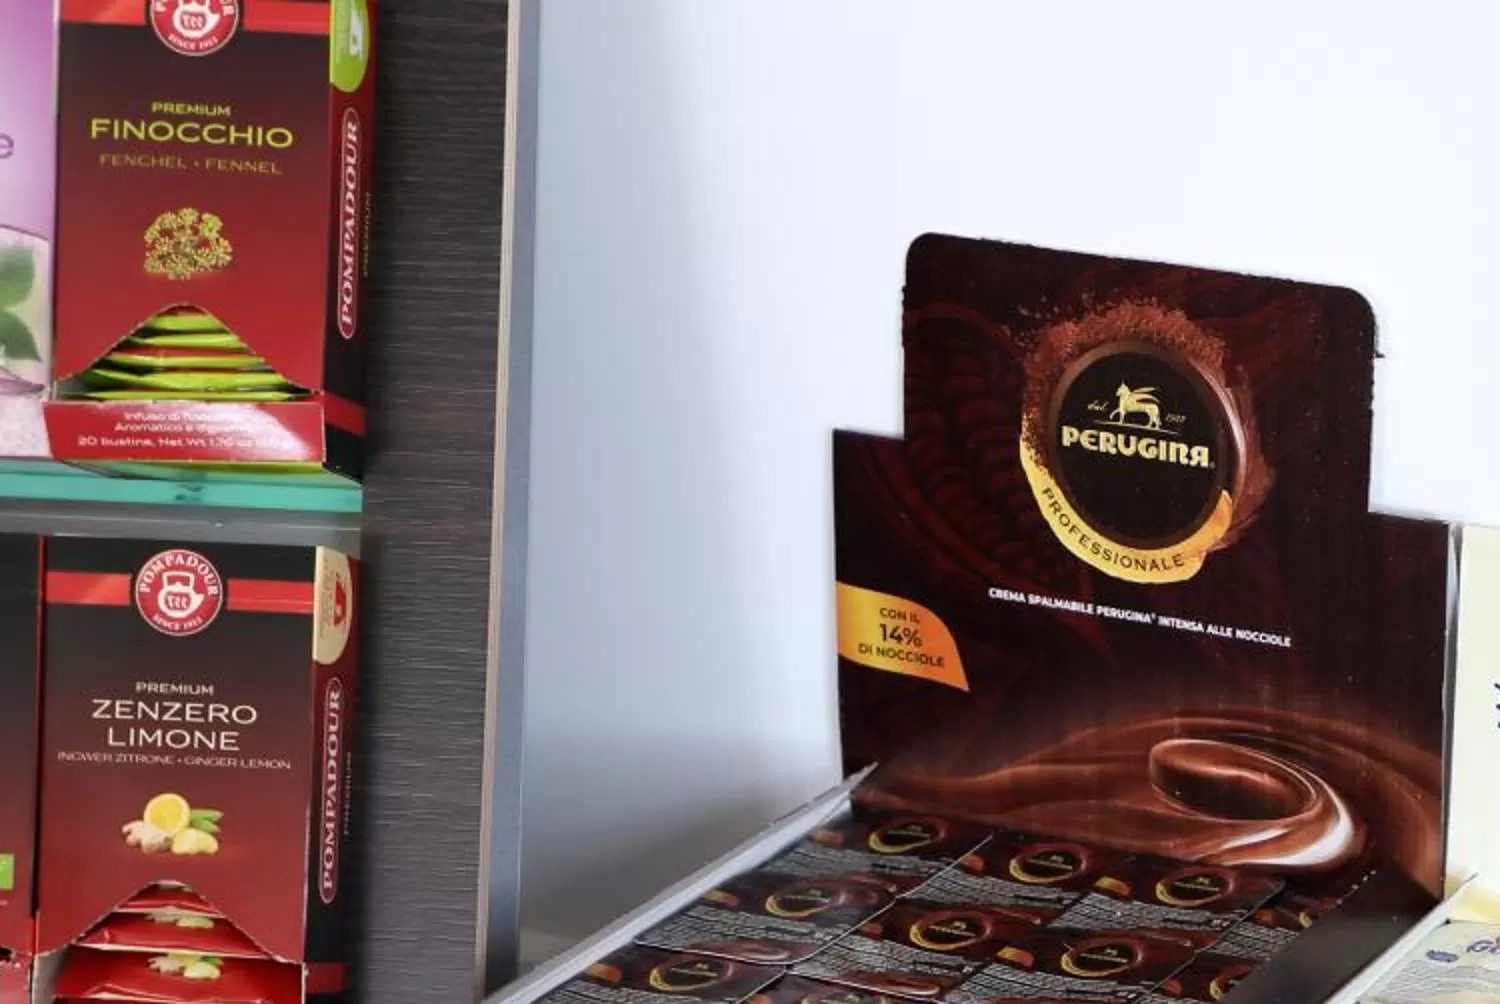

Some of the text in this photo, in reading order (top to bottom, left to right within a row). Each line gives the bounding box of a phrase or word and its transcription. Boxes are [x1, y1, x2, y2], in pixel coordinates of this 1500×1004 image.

[151, 101, 232, 118] PREMIUM
[90, 118, 294, 149] FINOCCHIO
[100, 152, 284, 175] FENCHEL FENNEL
[341, 120, 358, 325] POMPADOUR
[1061, 425, 1210, 469] PERUGINA
[1042, 487, 1185, 572] PROFESSIONALE
[140, 554, 219, 597] POMPADOUR
[880, 607, 907, 621] CON
[988, 587, 1026, 604] CREMA
[1028, 592, 1095, 615] SPALMABILE
[1157, 615, 1205, 633] INTENSA
[1206, 623, 1233, 638] ALLE
[1235, 628, 1292, 648] NOCCIOLE
[880, 623, 923, 648] 14%
[858, 643, 945, 668] DI NOCCIOLE
[136, 681, 214, 696] PREMIUM
[92, 699, 258, 725] ZENZERO
[107, 727, 241, 752] LIMONE
